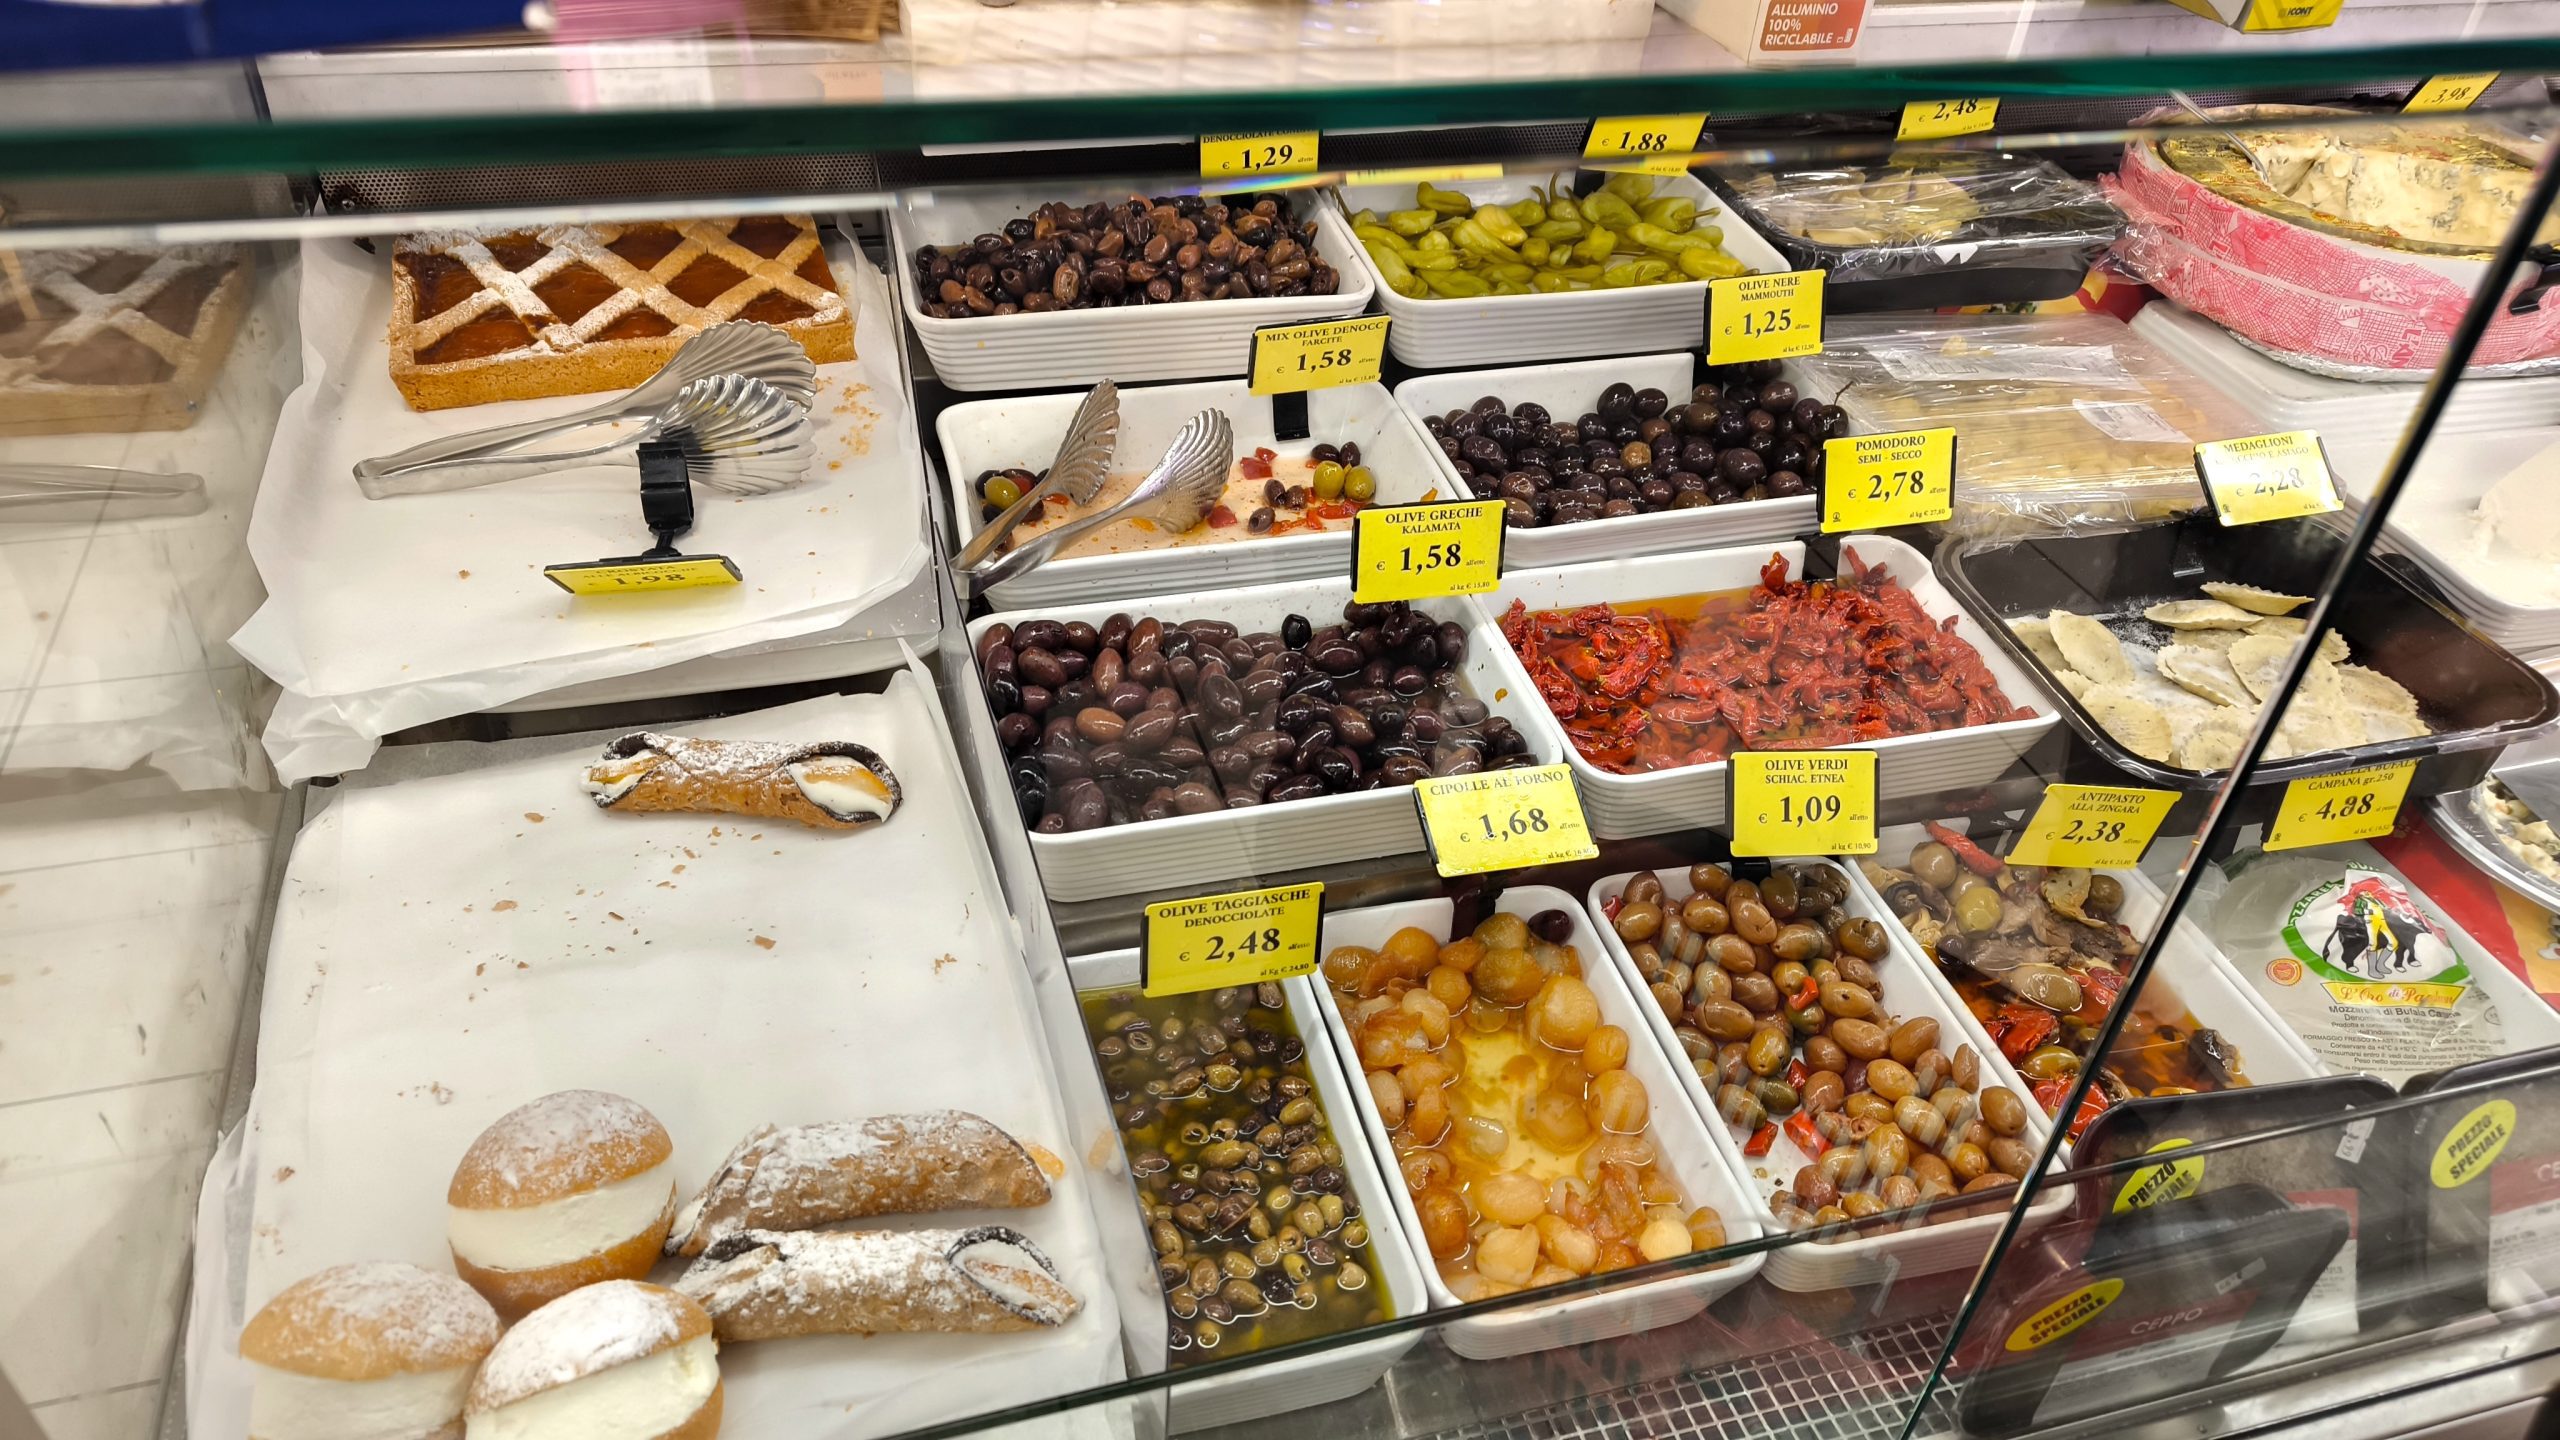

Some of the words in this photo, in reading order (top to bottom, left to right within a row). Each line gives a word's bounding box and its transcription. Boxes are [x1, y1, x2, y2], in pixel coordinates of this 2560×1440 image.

[1771, 2, 1839, 16] ALLUMINIO
[1769, 18, 1801, 32] 100%
[1765, 32, 1834, 46] RICICLABILE
[2431, 86, 2472, 105] 3,98
[1932, 98, 1978, 121] 2,48
[1602, 138, 1610, 147] €
[1619, 131, 1668, 152] 1,88
[1241, 144, 1293, 171] 1,29
[1738, 280, 1770, 291] OLIVE
[1773, 276, 1801, 287] NERE
[1740, 289, 1794, 302] MAMMOUTH
[1265, 332, 1289, 342] MIX
[1293, 328, 1329, 339] OLIVE
[1333, 321, 1384, 335] DENOCC
[1724, 326, 1732, 336] €
[1743, 308, 1791, 339] 1,25
[1302, 336, 1343, 346] FARCITE
[1276, 366, 1285, 374] €
[1296, 349, 1352, 373] 1,58
[1856, 435, 1926, 452] POMODORO
[2224, 436, 2294, 453] MEDAGLIONI
[1858, 454, 1882, 464] SEMI
[1890, 449, 1922, 461] SECCO
[1848, 489, 1857, 499] €
[1868, 470, 1924, 503] 2,78
[2236, 488, 2244, 497] €
[2249, 467, 2304, 496] 2,28
[1385, 511, 1426, 524] OLIVE
[1430, 507, 1483, 520] GRECHE
[1402, 522, 1461, 534] KALAMATA
[1376, 561, 1386, 571] €
[1400, 543, 1462, 575] 1,58
[615, 574, 686, 585] 1,98
[1456, 583, 1465, 591] kg
[1765, 759, 1805, 771] OLIVE
[1808, 759, 1849, 770] VERDI
[1430, 780, 1490, 796] CIPOLLE
[1765, 774, 1807, 784] SCHIAC.
[1810, 774, 1845, 783] ETNEA
[2308, 777, 2361, 791] CAMPANA
[2363, 772, 2395, 786] gr.250
[2077, 792, 2146, 804] ANTIPASTO
[1759, 813, 1768, 824] €
[1780, 795, 1841, 828] 1,09
[2068, 803, 2094, 812] ALLA
[2096, 803, 2140, 814] ZINGARA
[1460, 833, 1471, 843] €
[1478, 808, 1549, 842] 1,68
[2298, 813, 2308, 823] €
[2046, 831, 2055, 841] €
[2061, 819, 2126, 845] 2,38
[1838, 843, 1846, 851] kg
[1159, 903, 1208, 919] OLIVE
[1212, 888, 1311, 912] TAGGIASCHE
[1184, 906, 1285, 928] DENOCCIOLATE
[1179, 952, 1190, 962] €
[1205, 928, 1280, 963] 2,48
[1288, 963, 1309, 971] 24,80
[2395, 1008, 2426, 1017] Bufala
[2302, 1034, 2343, 1042] FORMAGGIO
[2448, 1114, 2492, 1159] PREZZO
[2449, 1123, 2506, 1180] SPECIALE
[2127, 1159, 2177, 1208] PREZZO
[2029, 1295, 2107, 1344] SPECIALE
[2031, 1292, 2092, 1331] PREZZO
[2130, 1307, 2204, 1335] CEPPO
